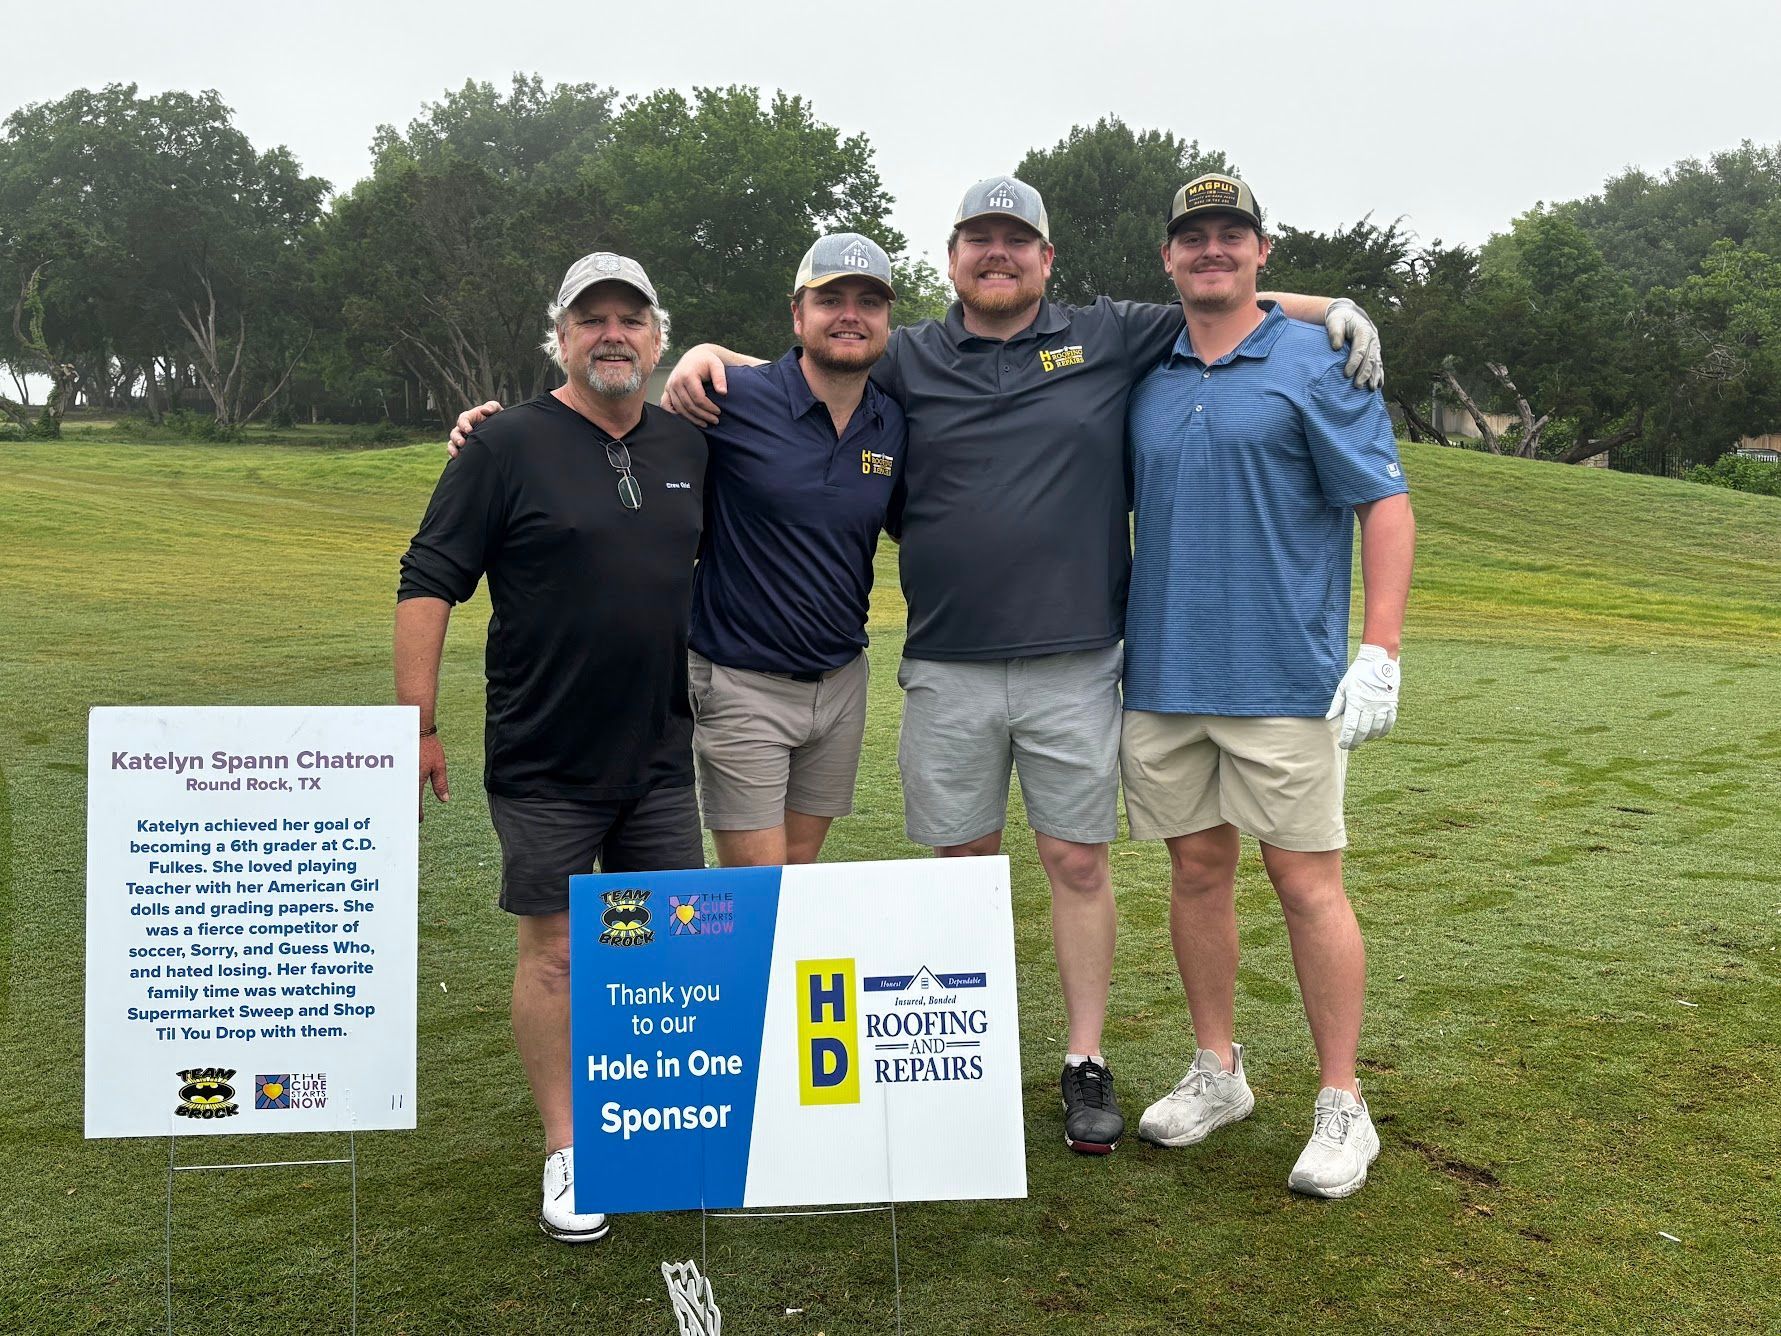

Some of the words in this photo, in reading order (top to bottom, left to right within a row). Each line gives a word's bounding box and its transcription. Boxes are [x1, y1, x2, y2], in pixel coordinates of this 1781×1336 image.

[1189, 182, 1235, 195] MAGPUL
[990, 198, 1013, 208] HD
[844, 255, 869, 268] HD
[1052, 350, 1082, 360] ROOFING
[1056, 358, 1084, 368] REPAIRS
[112, 752, 203, 774] Katelyn
[212, 751, 288, 774] Spann
[297, 751, 393, 769] Chatron
[187, 778, 240, 791] Round
[247, 778, 292, 792] Rock,
[298, 777, 321, 790] TX
[138, 820, 199, 835] Katelyn
[205, 818, 277, 831] achieved
[283, 819, 309, 830] her
[314, 818, 348, 833] goal
[354, 818, 370, 830] of
[131, 840, 210, 855] becoming
[216, 843, 225, 852] a
[231, 840, 258, 852] 6th
[263, 839, 317, 854] grader
[322, 840, 337, 851] at
[342, 838, 375, 850] C.D.
[150, 861, 207, 873] Fulkes.
[213, 861, 243, 873] She
[249, 860, 292, 872] loved
[298, 860, 356, 874] playing
[126, 882, 191, 894] Teacher
[196, 881, 231, 893] with
[237, 881, 263, 893] her
[268, 879, 345, 892] American
[351, 879, 378, 891] Girl
[601, 890, 652, 902] TEAM
[131, 903, 169, 915] dolls
[175, 903, 205, 915] and
[211, 901, 273, 917] grading
[279, 904, 338, 916] papers.
[344, 900, 374, 912] She
[701, 901, 733, 913] CURE
[701, 913, 733, 921] STARTS
[146, 927, 178, 936] was
[184, 927, 192, 935] a
[198, 922, 244, 935] fierce
[249, 921, 338, 937] competitor
[343, 921, 359, 933] of
[701, 922, 733, 934] NOW
[599, 932, 655, 946] BROCK
[129, 947, 185, 958] soccer,
[191, 944, 238, 959] Sorry,
[243, 943, 273, 955] and
[279, 942, 328, 954] Guess
[333, 941, 374, 955] Who,
[130, 966, 160, 978] and
[167, 965, 212, 977] hated
[219, 963, 271, 979] losing.
[278, 963, 306, 975] Her
[311, 961, 373, 974] favorite
[949, 977, 981, 986] Dependable
[147, 985, 198, 1001] family
[203, 985, 239, 997] time
[244, 987, 276, 996] was
[281, 982, 355, 998] watching
[607, 981, 674, 1005] Thank
[680, 985, 719, 1008] you
[895, 997, 926, 1006] Insured,
[929, 995, 956, 1004] Bonded
[128, 1006, 234, 1022] Supermarket
[240, 1005, 293, 1020] Sweep
[299, 1004, 328, 1016] and
[334, 1003, 375, 1018] Shop
[632, 1015, 653, 1035] to
[661, 1016, 696, 1033] our
[866, 1010, 988, 1037] ROOFING
[156, 1027, 175, 1040] Til
[181, 1027, 210, 1039] You
[217, 1027, 256, 1041] Drop
[261, 1025, 295, 1037] with
[301, 1025, 347, 1037] them.
[910, 1038, 945, 1054] AND
[588, 1054, 648, 1081] Hole
[657, 1050, 679, 1077] in
[688, 1050, 742, 1076] One
[875, 1055, 983, 1083] REPAIRS
[176, 1068, 237, 1083] TEAM
[291, 1081, 326, 1090] CURE
[291, 1098, 326, 1108] NOW
[174, 1104, 239, 1119] BROCK
[601, 1102, 731, 1140] Sponsor
